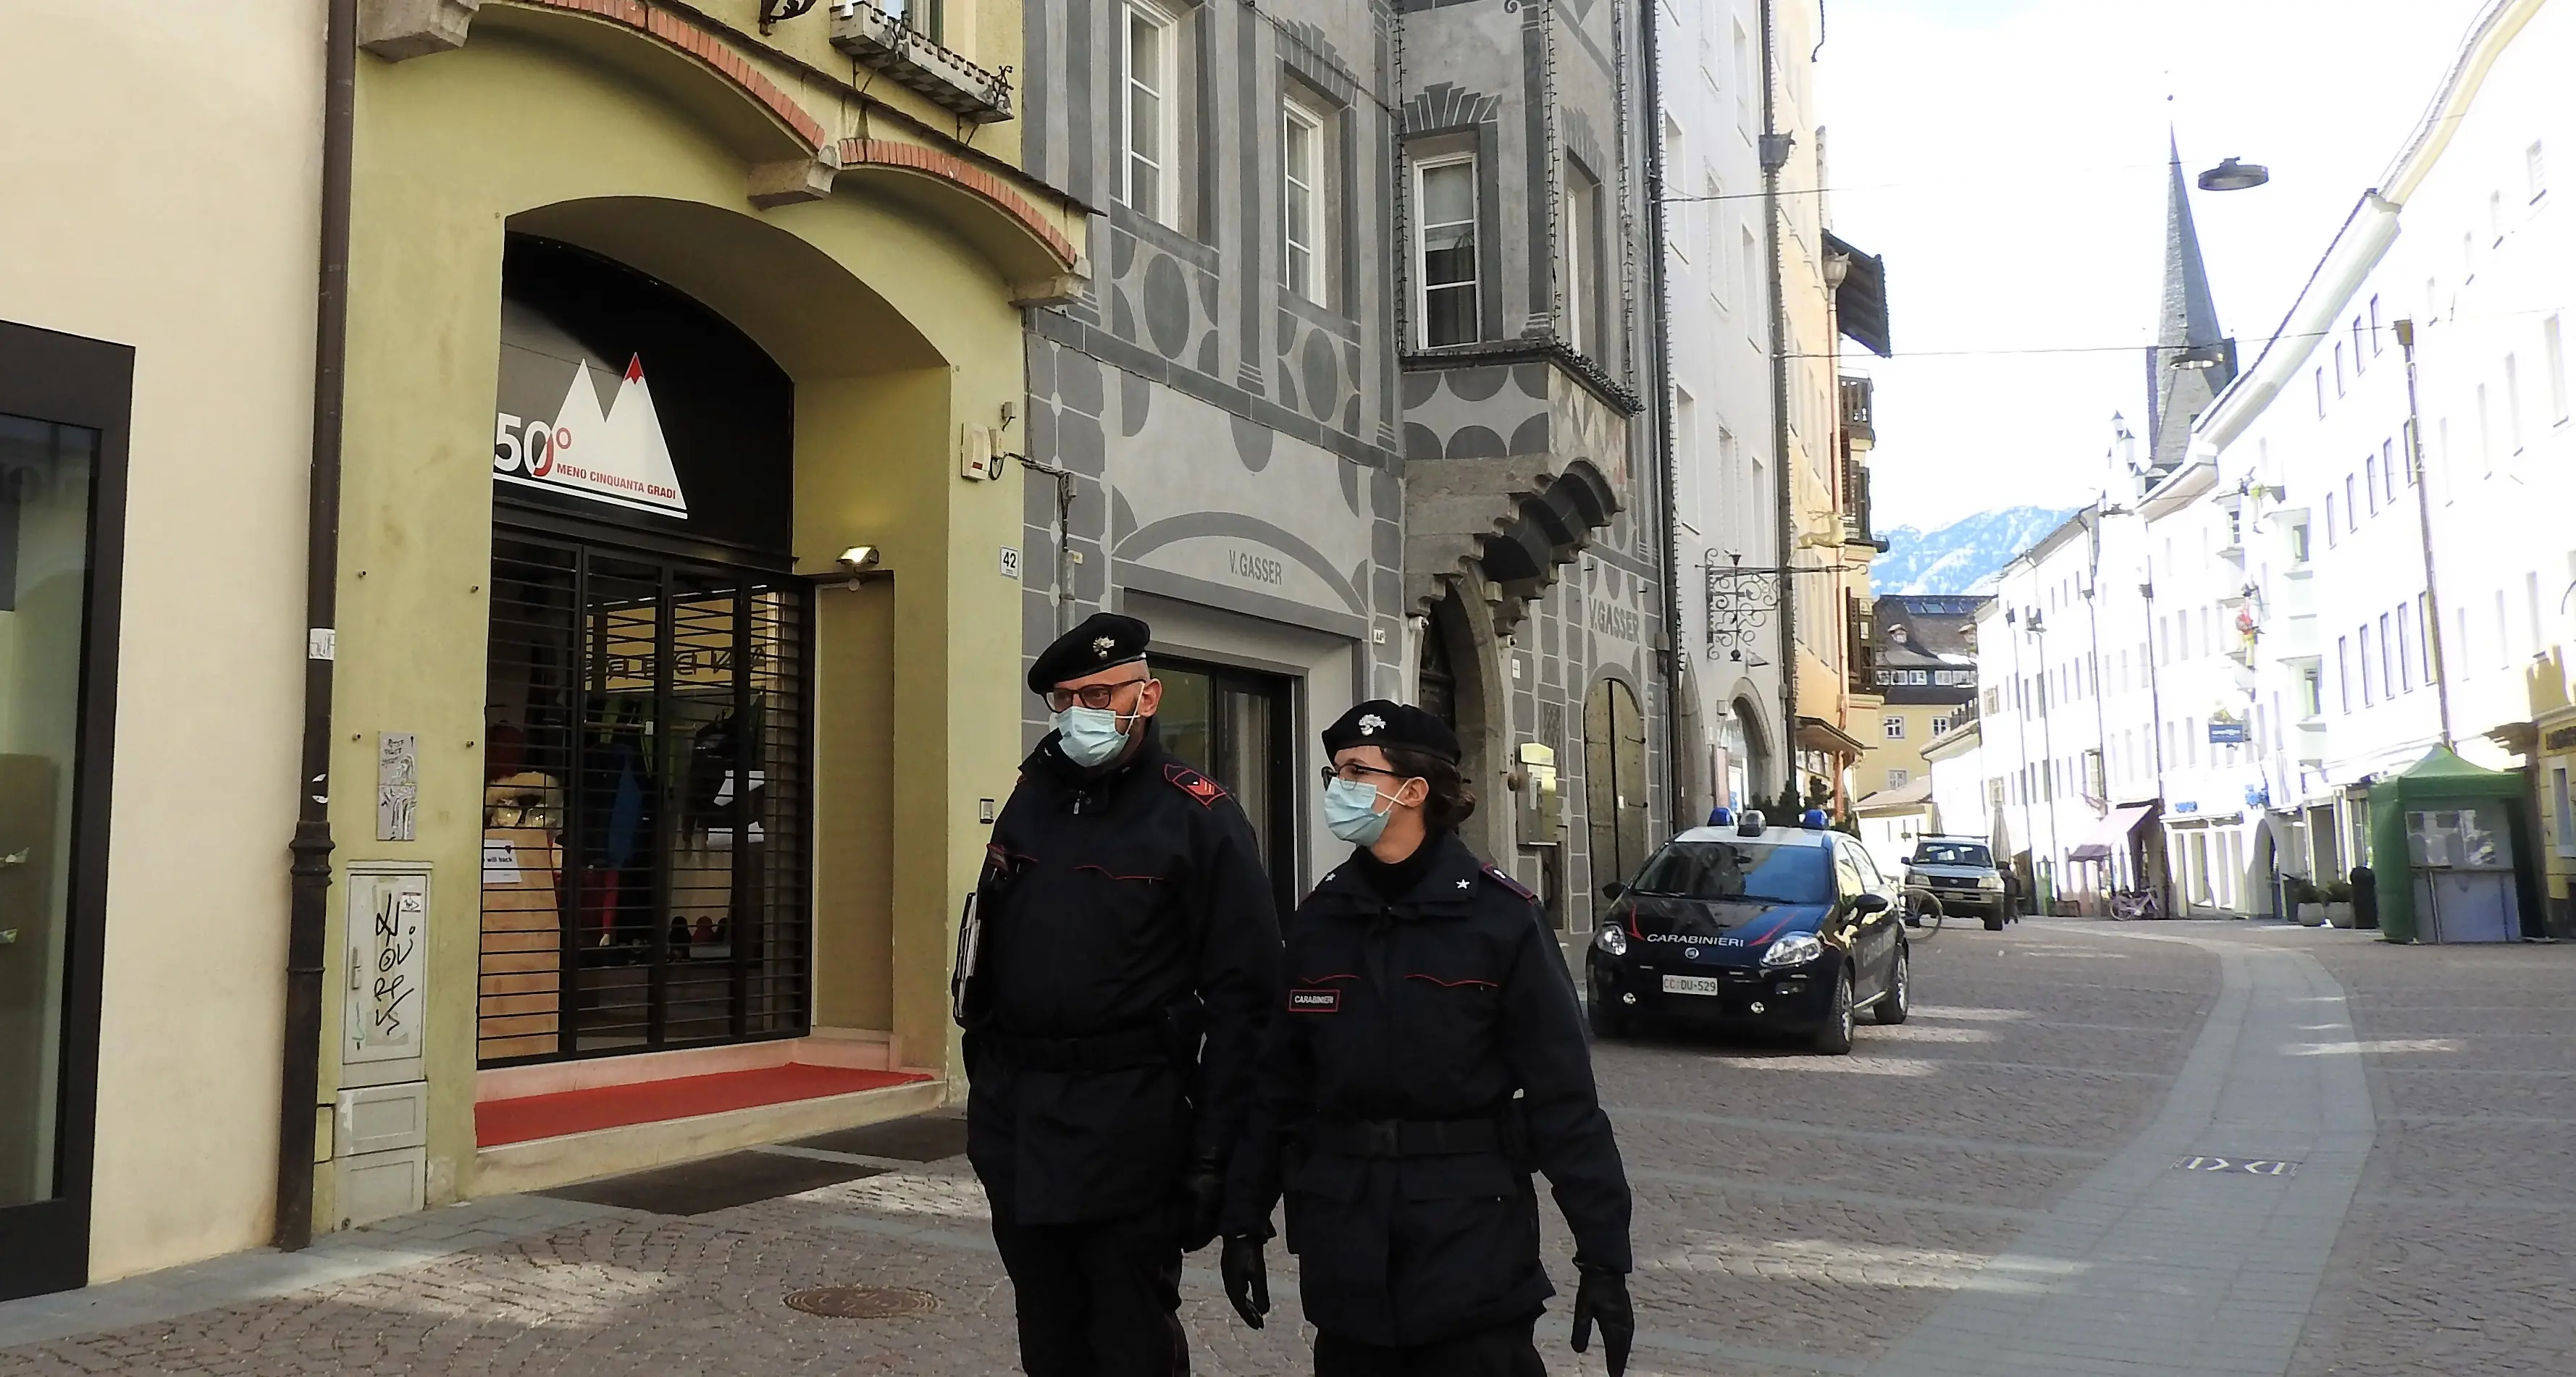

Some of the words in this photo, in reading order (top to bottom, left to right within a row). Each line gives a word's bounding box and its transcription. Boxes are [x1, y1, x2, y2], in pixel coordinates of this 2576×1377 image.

[556, 463, 587, 479] MENO
[590, 471, 645, 492] CINQUANTA
[647, 484, 676, 500] GRADI
[1003, 551, 1017, 569] 42
[1647, 933, 1745, 947] CARABINIERI
